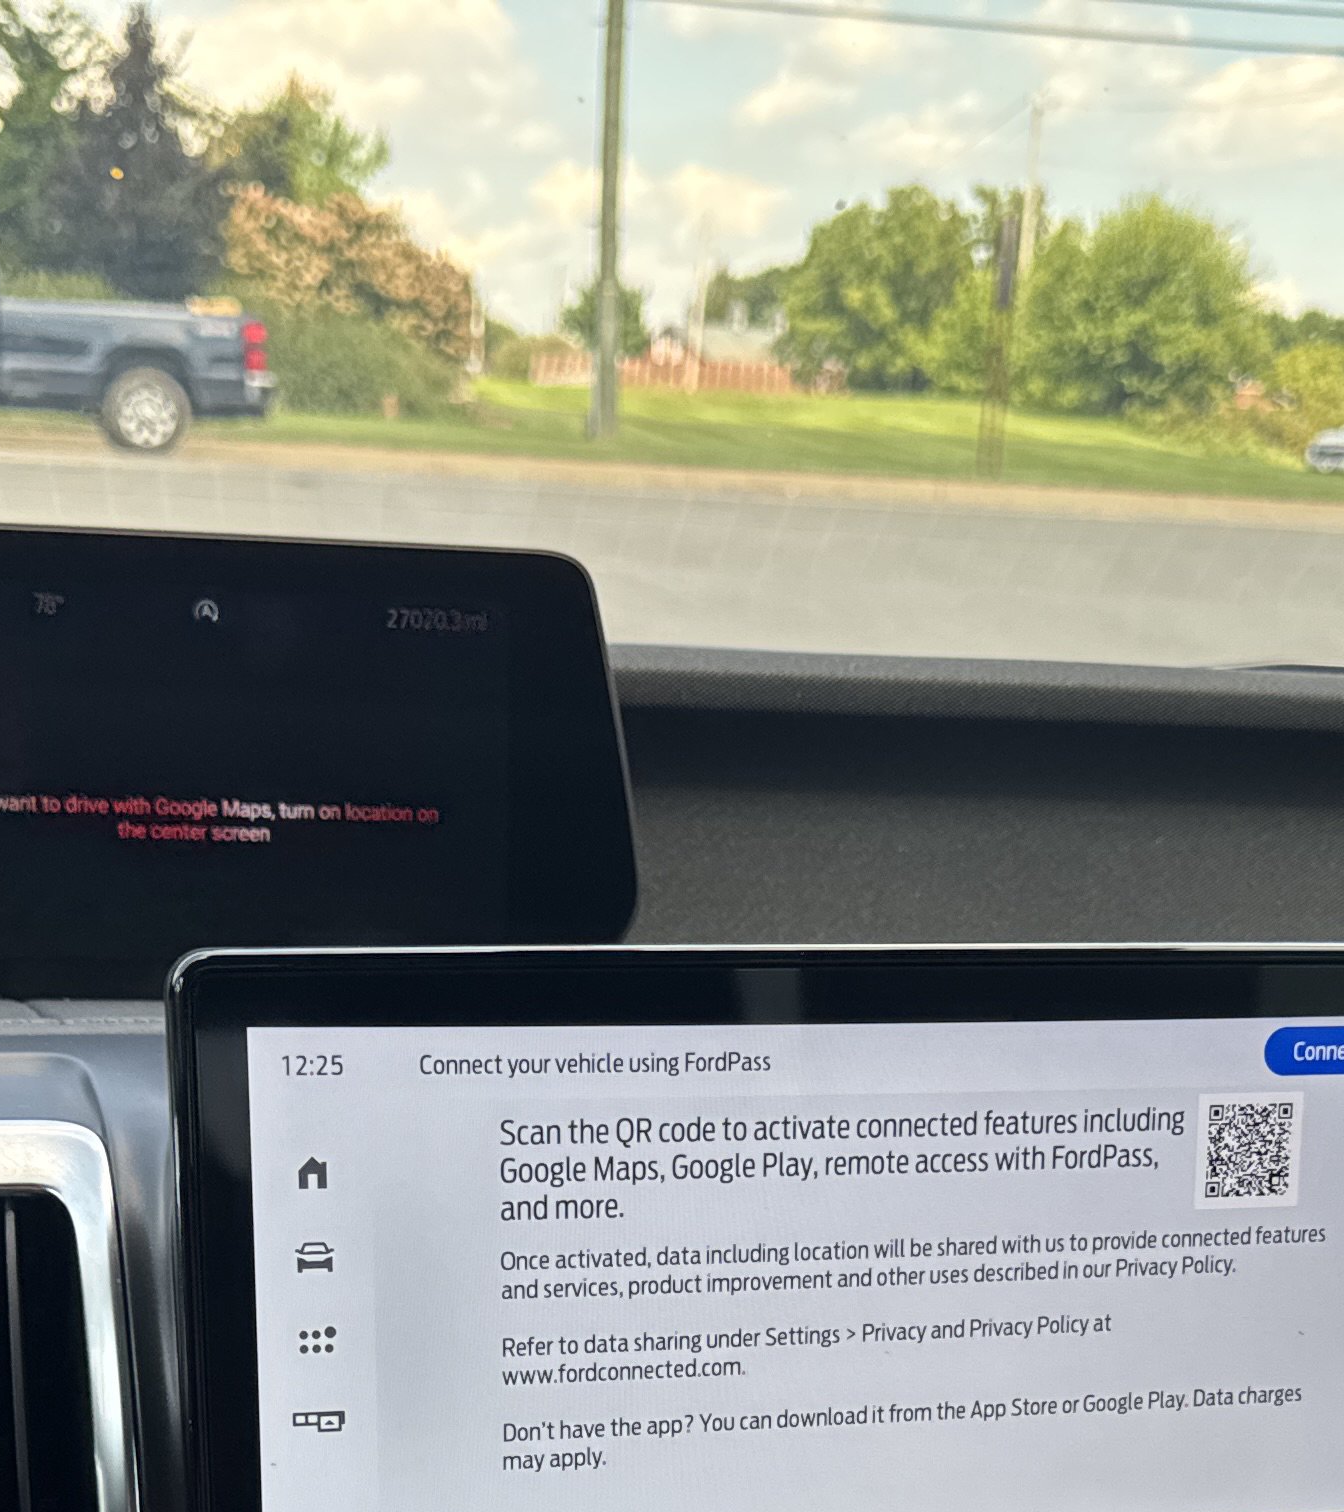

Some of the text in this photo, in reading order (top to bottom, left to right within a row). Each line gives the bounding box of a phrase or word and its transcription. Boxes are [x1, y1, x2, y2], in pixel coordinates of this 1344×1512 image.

[42, 797, 62, 814] to
[64, 794, 110, 815] drive
[112, 796, 151, 816] with
[155, 797, 219, 819] Google
[221, 799, 276, 821] Maps,
[278, 801, 315, 820] turn
[318, 804, 342, 821] on
[344, 802, 413, 822] location
[416, 806, 439, 824] on
[117, 820, 272, 842] the center screen
[281, 1054, 344, 1077] 12:25
[419, 1050, 771, 1079] Connect your vehicle using FordPass
[499, 1106, 1186, 1149] Scan the QR code to activate connected features including
[500, 1143, 1159, 1188] Google Maps, Google Play, remote access with FordPass,
[500, 1193, 624, 1222] and more.
[500, 1225, 1327, 1271] Once activated, data including location will be shared with us to provide connected features
[501, 1254, 1237, 1300] and services, product improvement and other uses described in our Privacy Policy.
[502, 1336, 554, 1358] Refer
[557, 1336, 579, 1355] to
[583, 1333, 629, 1353] data
[633, 1330, 702, 1354] sharing
[706, 1327, 761, 1349] under
[765, 1325, 841, 1348] Settings
[862, 1322, 928, 1344] Privacy
[930, 1318, 966, 1340] and
[969, 1318, 1034, 1340] Privacy
[1036, 1314, 1090, 1337] Policy
[1093, 1313, 1112, 1333] at
[501, 1357, 746, 1386] www.fordconnected.com.
[503, 1385, 1303, 1443] Don't have the app? You can download it from the App Store or Google Play. Data charges
[502, 1446, 607, 1473] may apply.
